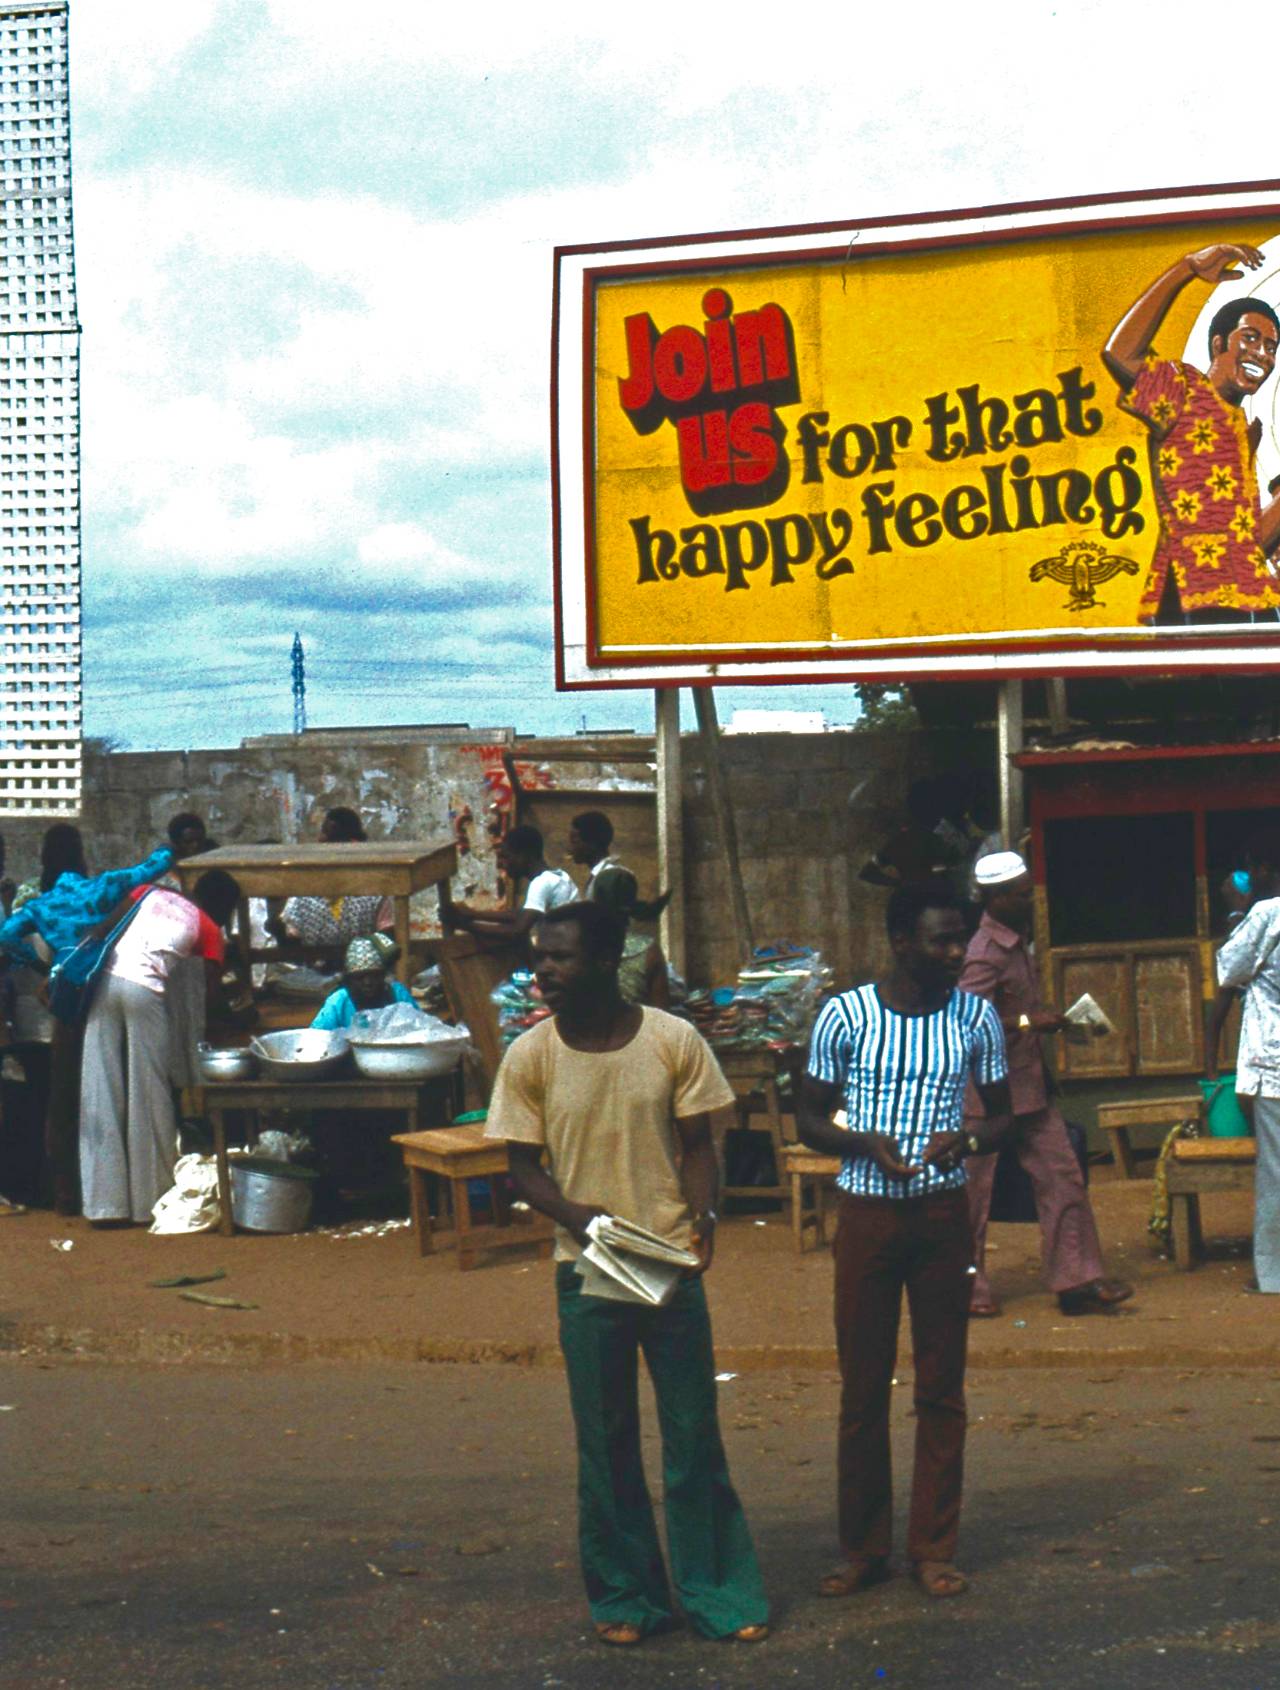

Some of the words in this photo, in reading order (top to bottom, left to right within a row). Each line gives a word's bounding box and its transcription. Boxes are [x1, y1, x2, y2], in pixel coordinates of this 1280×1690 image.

[617, 287, 799, 425] Join
[677, 402, 787, 511] us
[796, 411, 912, 484] for
[923, 366, 1103, 461] that
[628, 508, 855, 592] happy
[861, 445, 1145, 555] feeling
